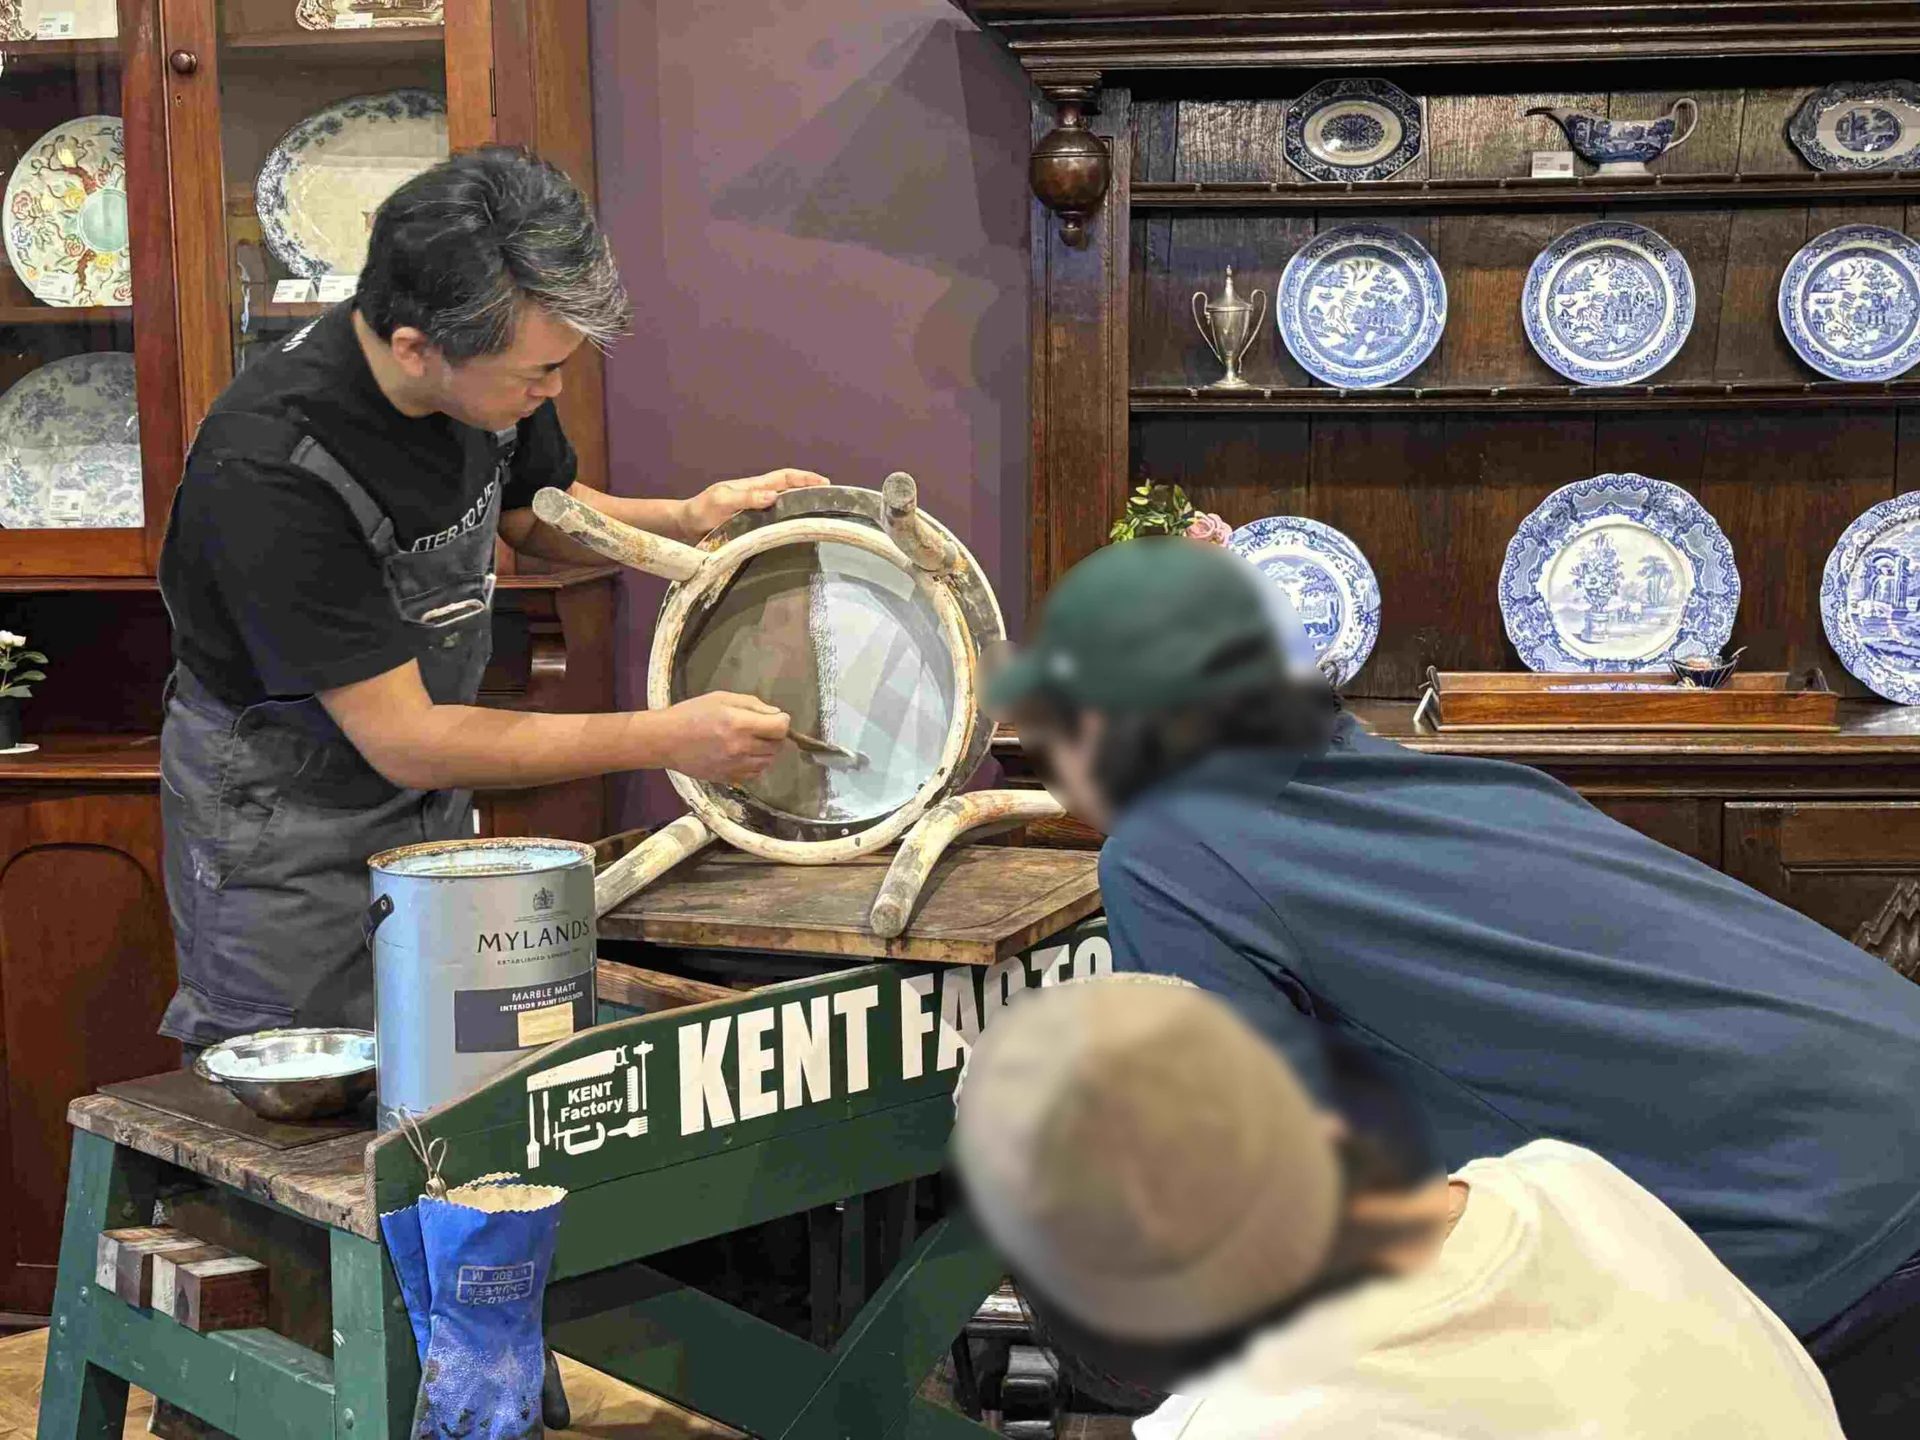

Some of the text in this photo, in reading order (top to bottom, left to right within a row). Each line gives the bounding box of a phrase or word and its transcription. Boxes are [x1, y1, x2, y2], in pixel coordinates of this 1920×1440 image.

[460, 507, 476, 532] TO
[477, 916, 590, 953] MYLANDS
[500, 1002, 536, 1011] INTERIOR
[537, 998, 557, 1008] PAINT
[512, 982, 576, 1002] MARBLE MATT
[678, 985, 878, 1136] KENT
[568, 1081, 613, 1105] KENT
[560, 1097, 623, 1123] Factory
